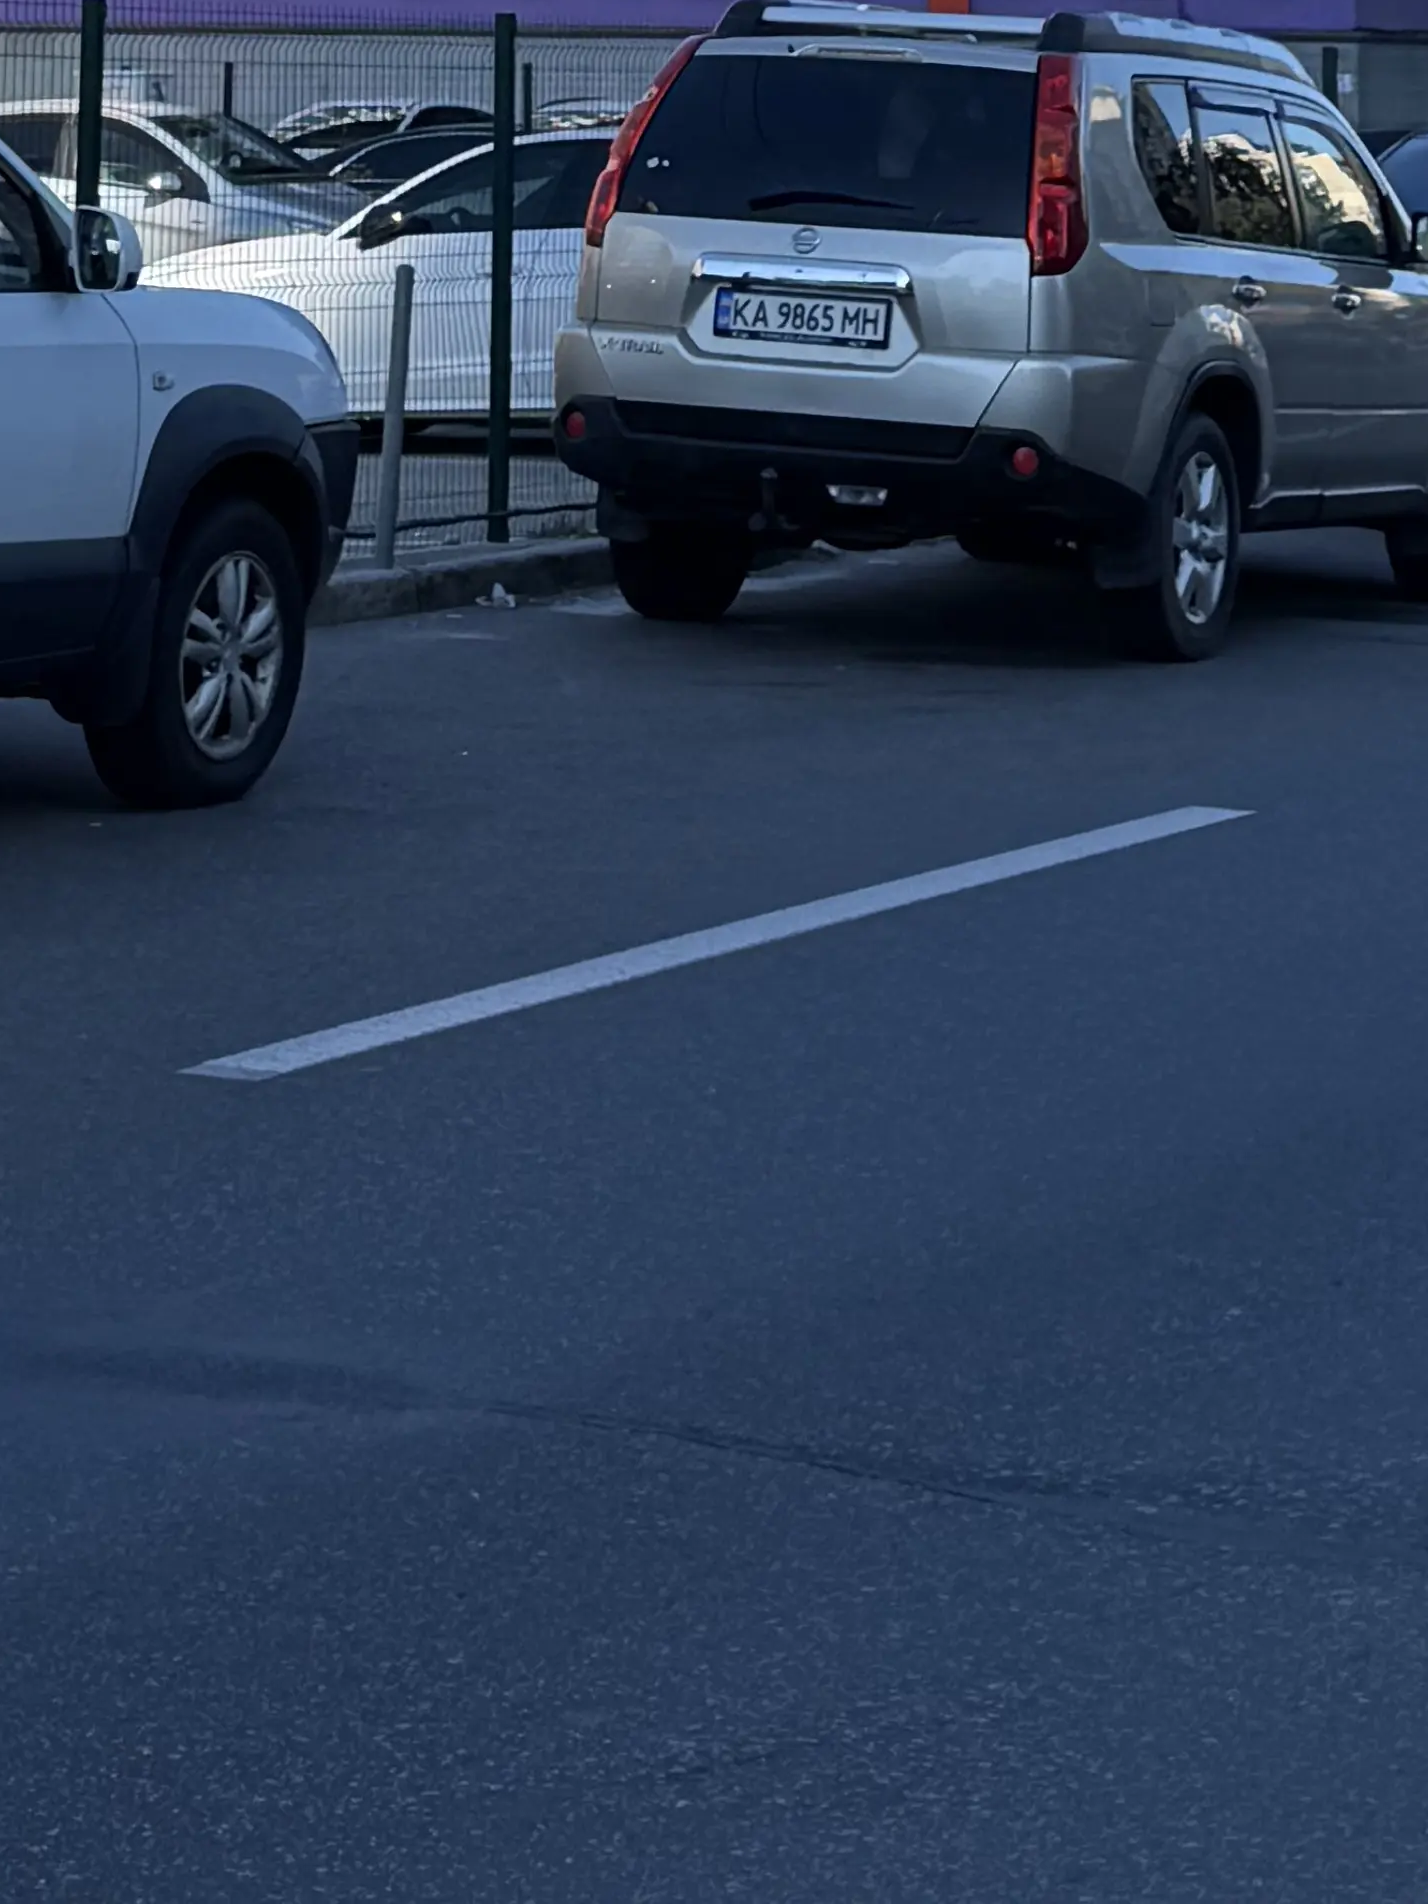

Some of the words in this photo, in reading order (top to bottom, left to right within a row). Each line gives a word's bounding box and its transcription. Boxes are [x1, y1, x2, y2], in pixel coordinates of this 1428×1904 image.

[732, 298, 769, 328] KA
[776, 301, 835, 332] 9865
[840, 306, 879, 336] MH
